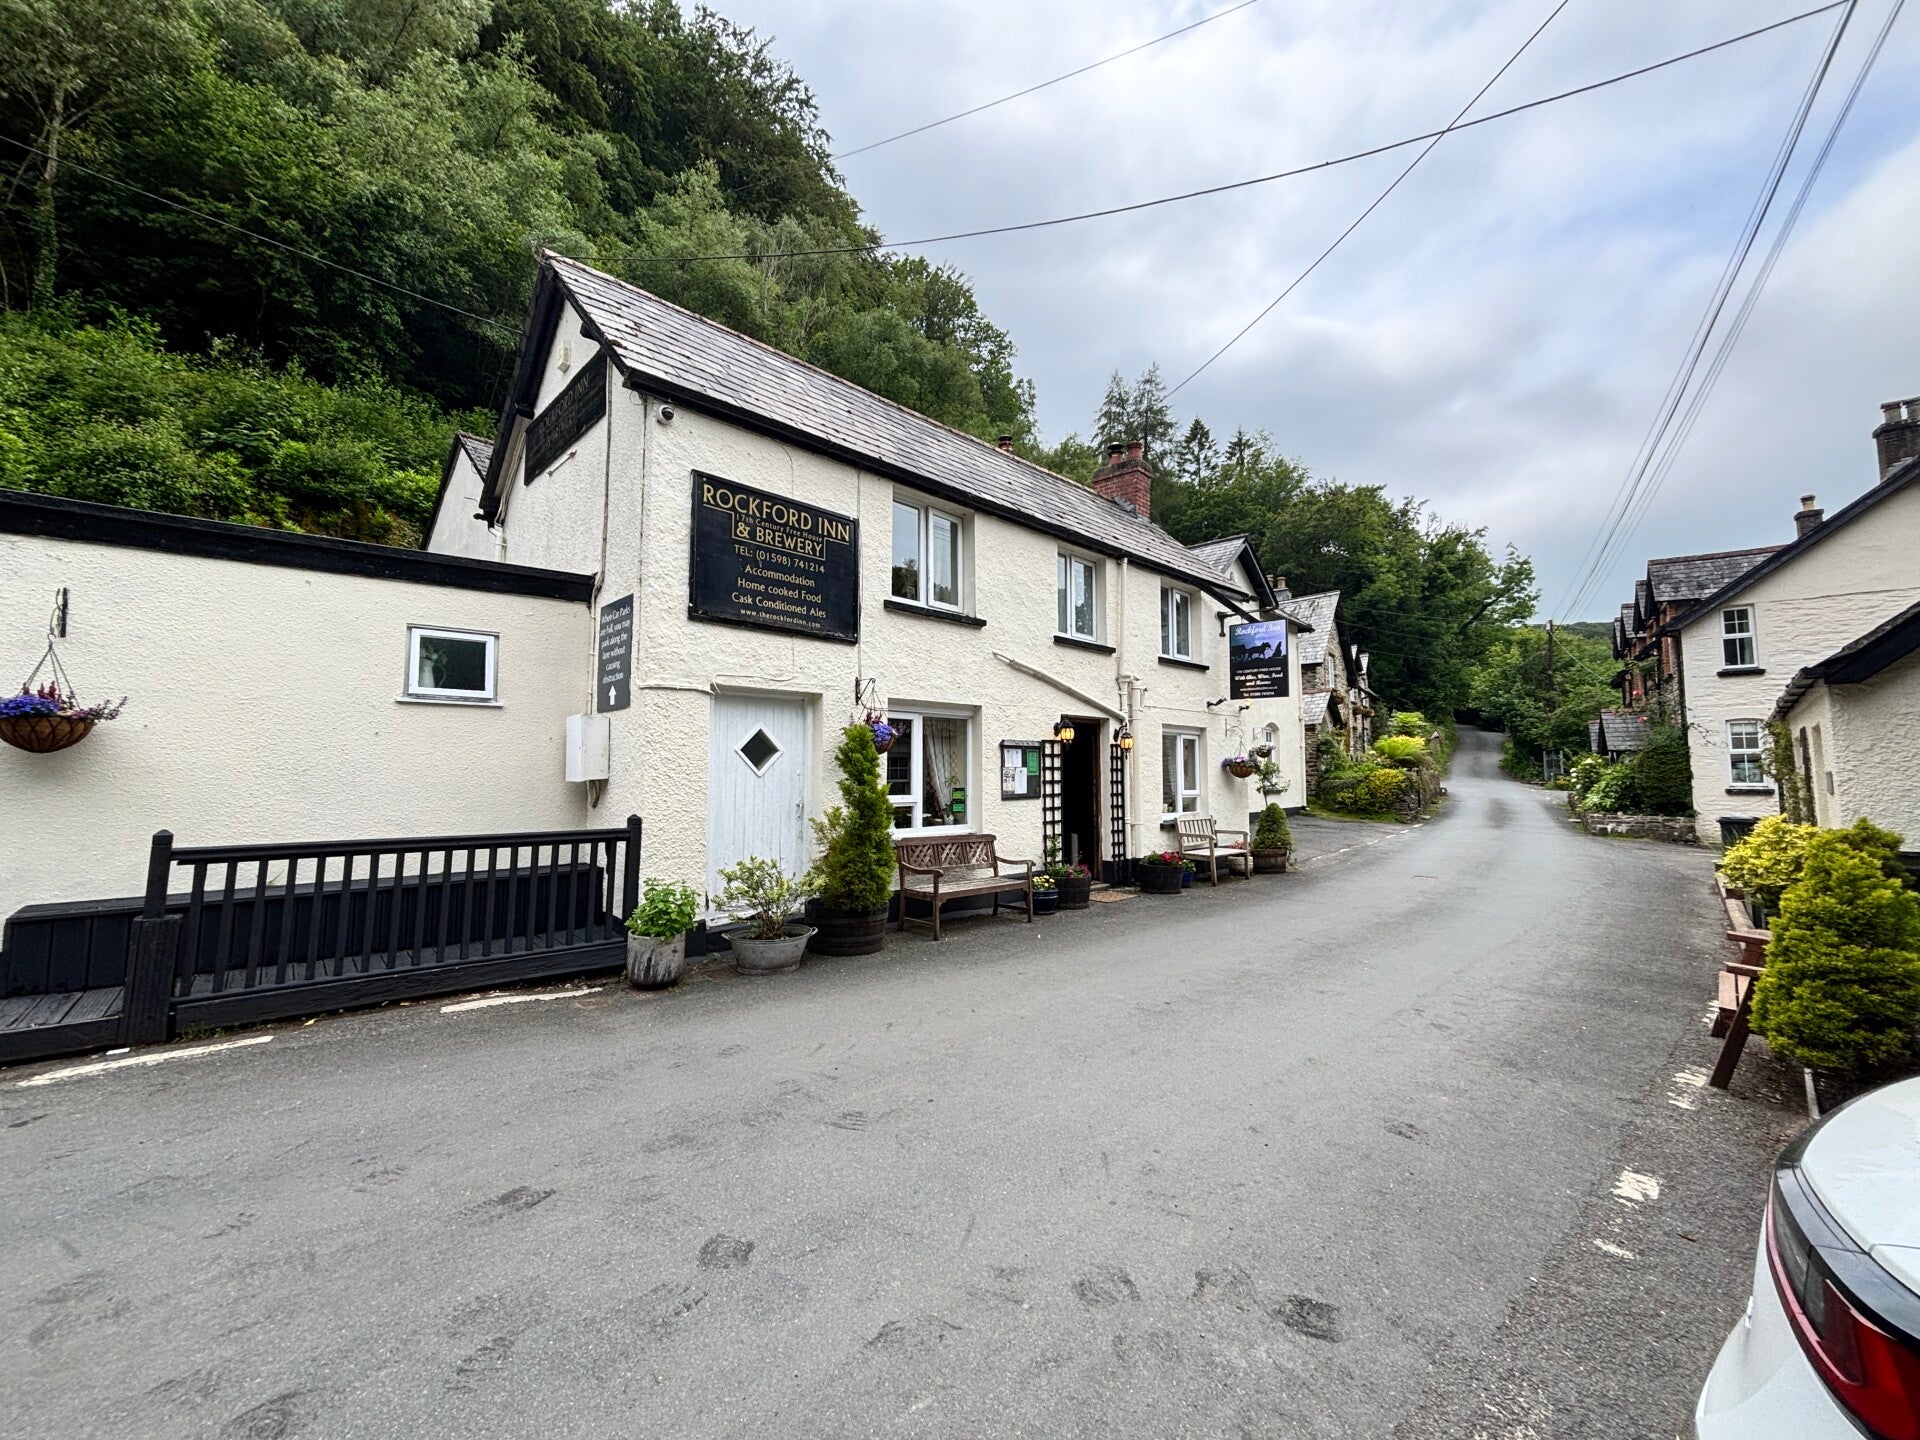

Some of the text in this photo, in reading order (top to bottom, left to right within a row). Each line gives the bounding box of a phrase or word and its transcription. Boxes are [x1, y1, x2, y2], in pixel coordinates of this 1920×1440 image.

[703, 484, 850, 542] ROCKFORD INN
[736, 514, 823, 542] 17th Century Free House
[736, 522, 823, 556] & BREWERY
[734, 544, 825, 574] TEL: (01598) 741214
[744, 564, 815, 588] Accommodation
[737, 577, 822, 604] Home cooked Food
[732, 592, 826, 618] Cask Conditioned Ales
[740, 609, 821, 628] www.therockfordinn.com
[1235, 626, 1266, 636] Rockford
